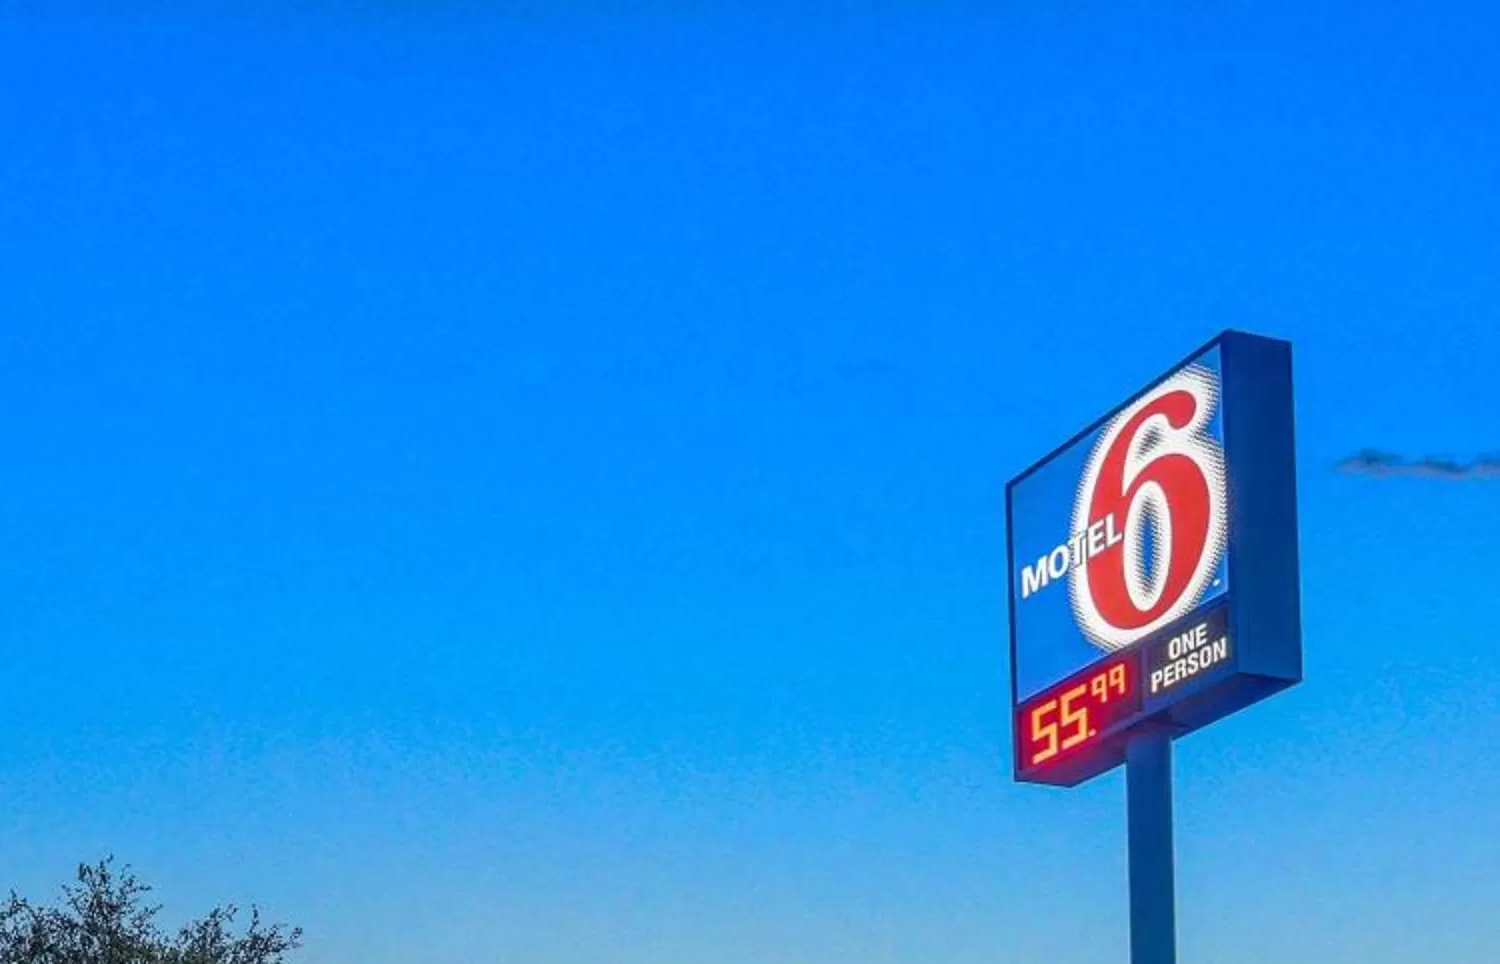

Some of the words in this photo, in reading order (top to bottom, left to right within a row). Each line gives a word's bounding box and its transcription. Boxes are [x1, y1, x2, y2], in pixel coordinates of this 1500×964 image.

[1021, 513, 1124, 598] MOTEL
[1086, 388, 1211, 631] 6
[1150, 638, 1228, 694] PERSON
[1167, 623, 1208, 659] ONE
